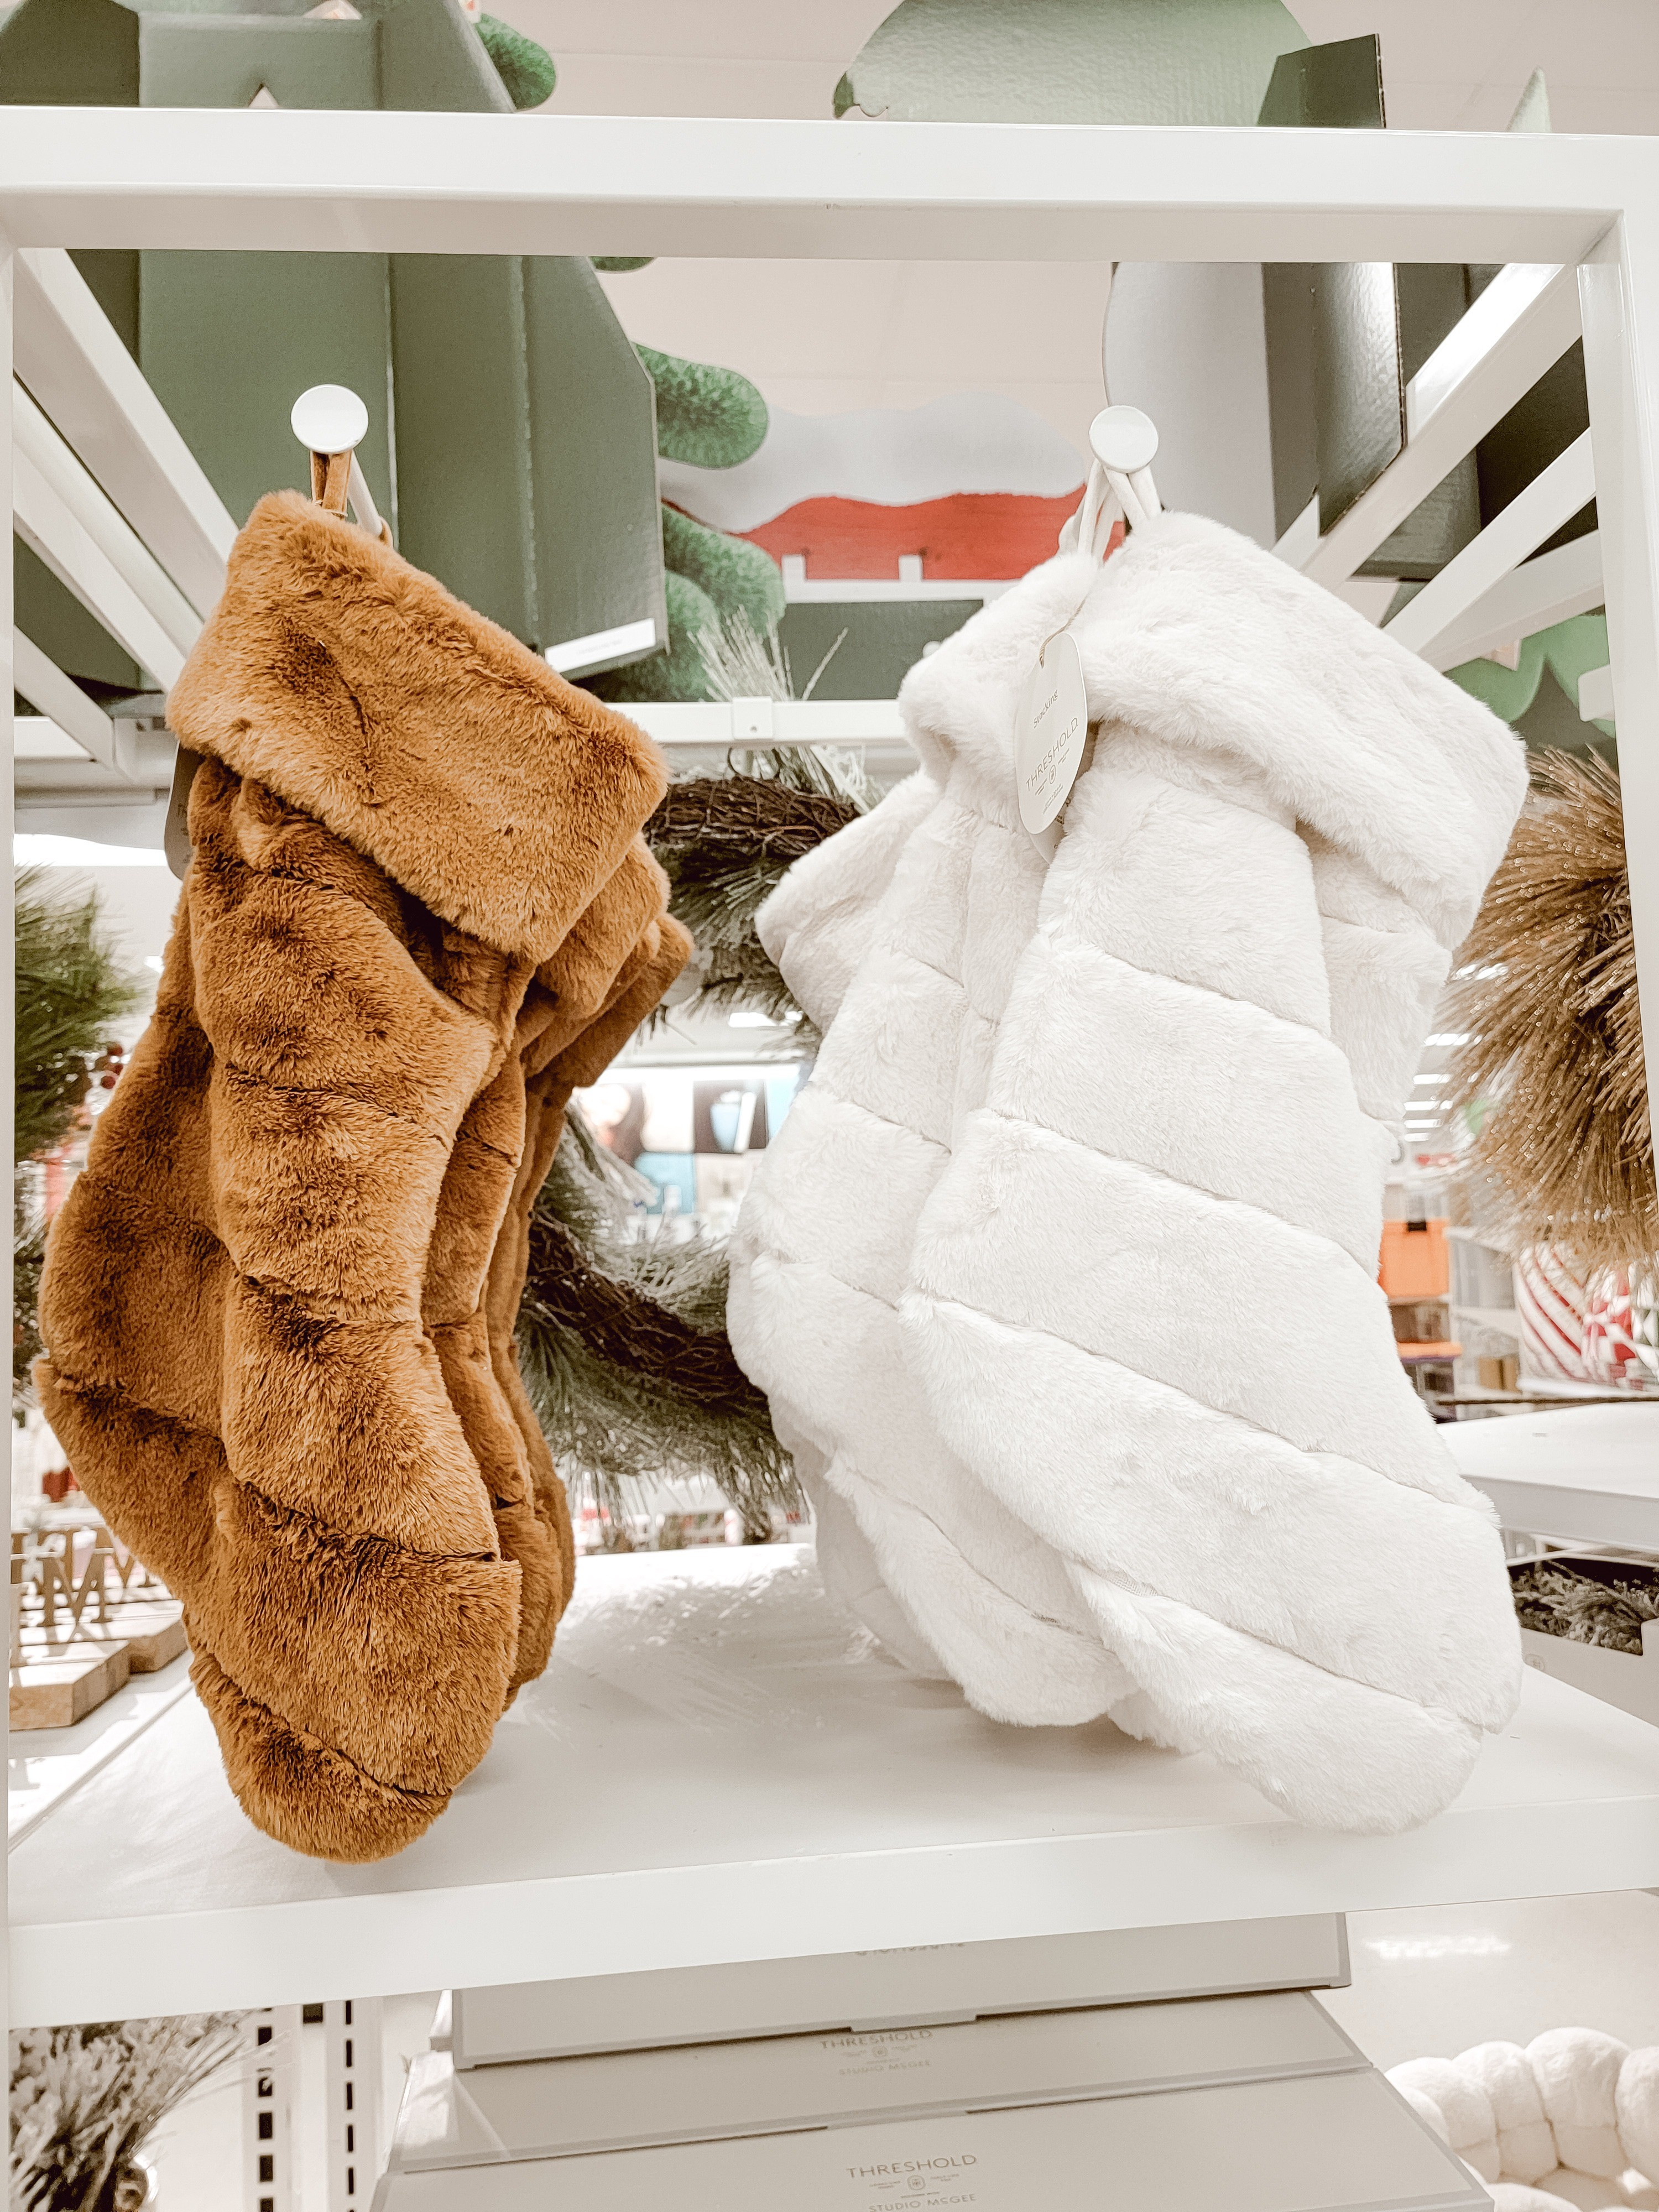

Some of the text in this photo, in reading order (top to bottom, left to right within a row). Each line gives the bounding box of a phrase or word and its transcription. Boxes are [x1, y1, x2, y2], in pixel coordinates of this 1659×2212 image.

[1033, 689, 1058, 729] Stocking
[1026, 717, 1078, 792] THRESHOLD
[820, 2030, 933, 2049] THRESHOLD
[846, 2154, 978, 2178] THRESHOLD
[869, 2201, 921, 2212] STUDIO
